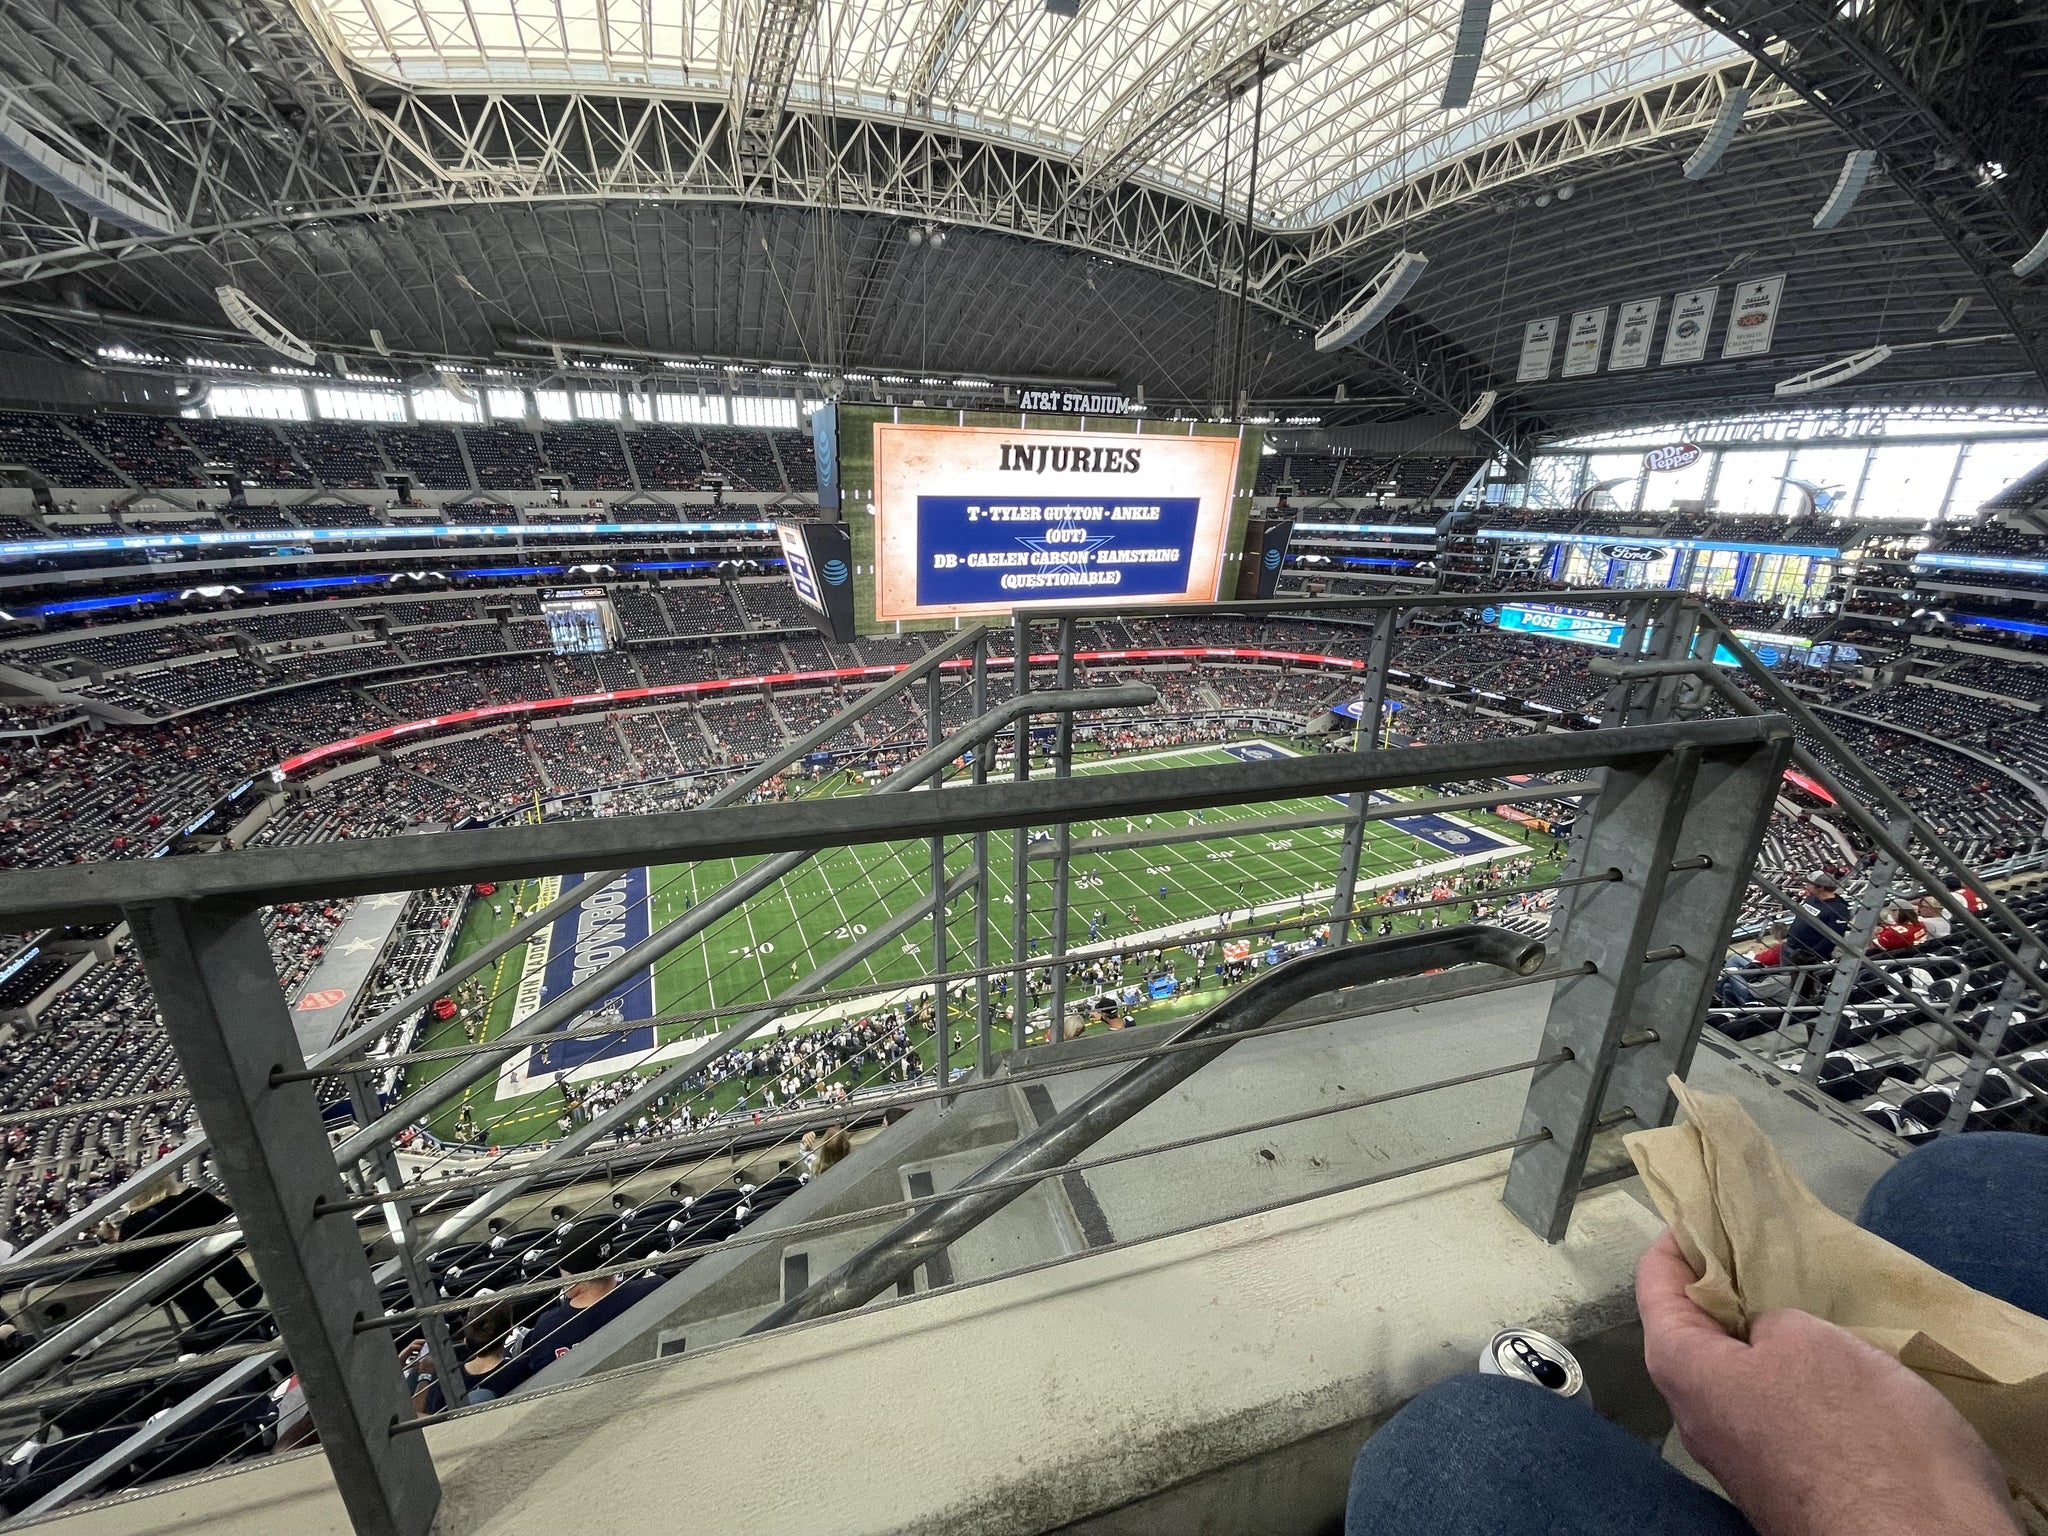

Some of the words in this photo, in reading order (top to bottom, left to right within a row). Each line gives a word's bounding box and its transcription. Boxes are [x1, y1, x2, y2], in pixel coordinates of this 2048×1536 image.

[1020, 391, 1061, 411] AT&T
[1062, 393, 1130, 414] STADIUM
[999, 444, 1142, 474] INJURIES
[1648, 448, 1699, 470] Pepper
[1661, 446, 1684, 458] Dr
[967, 507, 981, 521] T
[989, 506, 1042, 521] TYLER
[1043, 506, 1103, 521] GUYTON
[1111, 506, 1160, 521] ANKLE
[1045, 528, 1087, 544] (OUT)
[934, 554, 957, 569] DB
[967, 552, 1029, 568] CAELEN
[1031, 550, 1089, 567] CARSON
[1097, 548, 1180, 565] HAMSTRING
[1611, 545, 1653, 561] Ford
[1001, 570, 1121, 589] (QUESTIONABLE)
[1521, 613, 1560, 629] POSE
[835, 923, 868, 940] 20
[741, 942, 775, 958] 10
[518, 979, 540, 1010] JOHN
